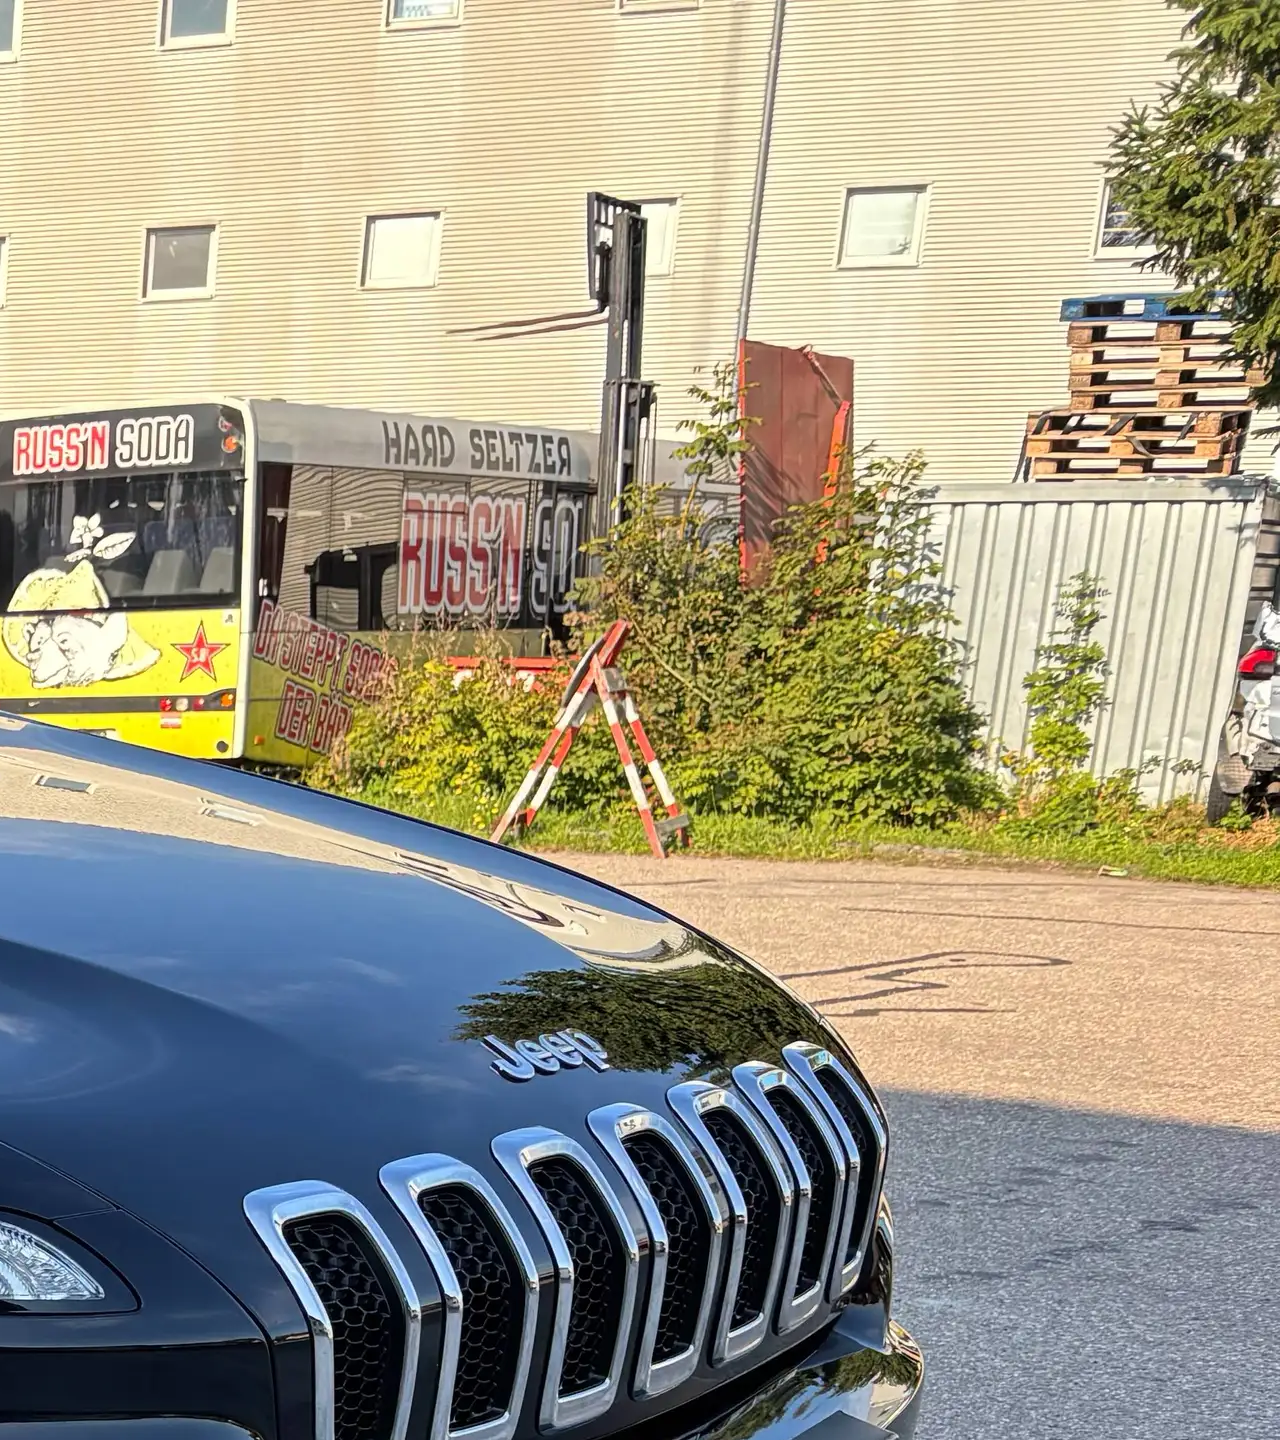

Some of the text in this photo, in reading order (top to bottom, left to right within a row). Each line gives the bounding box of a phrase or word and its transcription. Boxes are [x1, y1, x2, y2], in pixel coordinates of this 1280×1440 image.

[13, 414, 194, 475] RUSS'N SODA
[398, 490, 527, 620] RUSS'N
[275, 678, 316, 748] DER
[479, 1027, 610, 1083] Jeep
